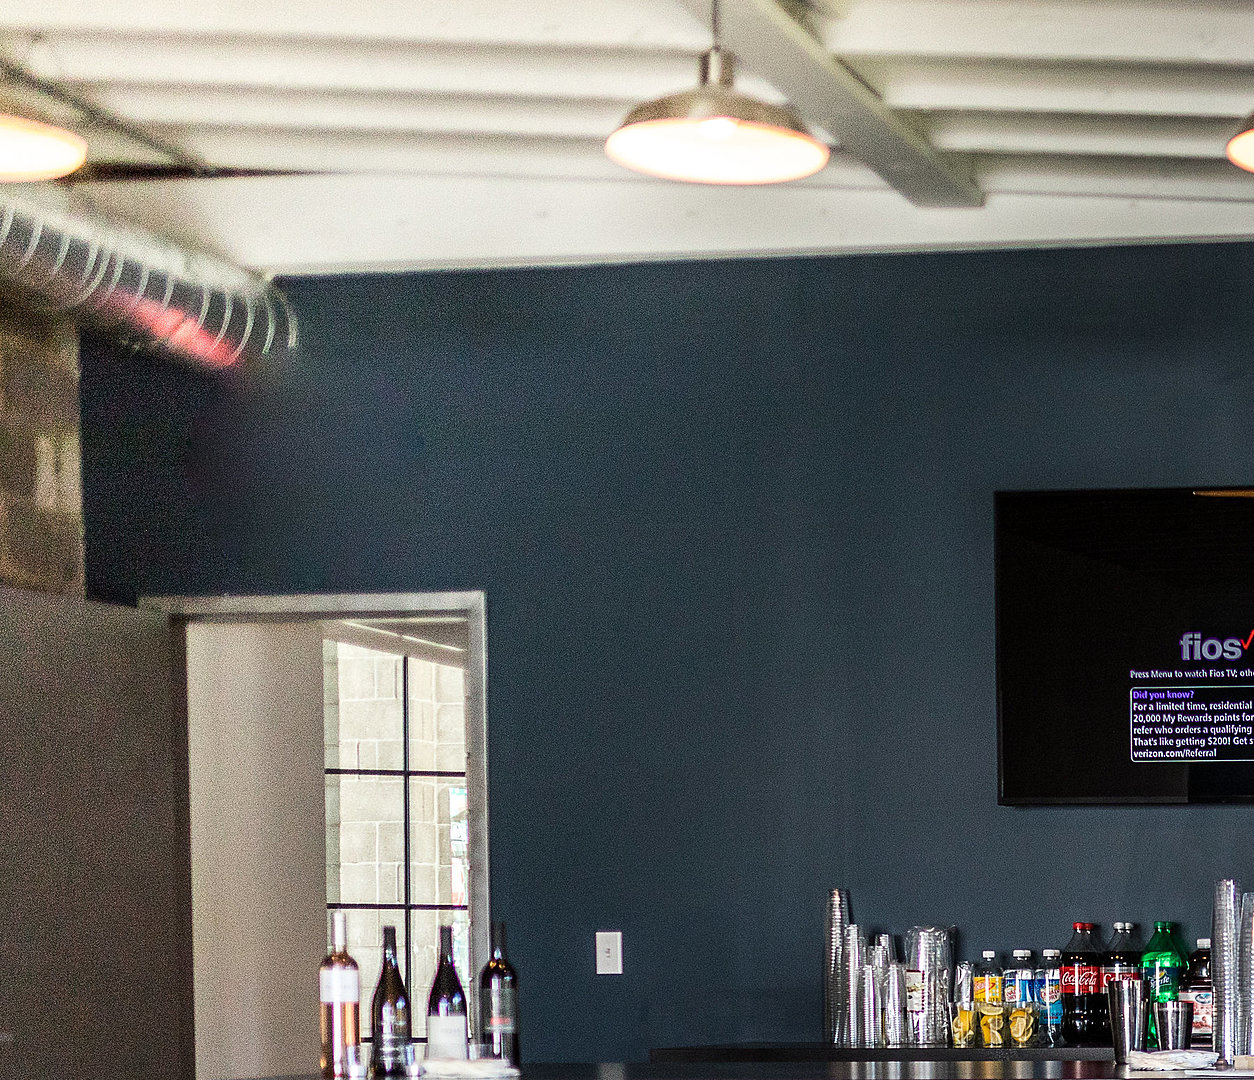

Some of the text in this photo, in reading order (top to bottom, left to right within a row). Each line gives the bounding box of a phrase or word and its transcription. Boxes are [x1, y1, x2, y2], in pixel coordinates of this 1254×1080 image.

[1179, 631, 1242, 661] fios
[1130, 669, 1150, 678] Press
[1151, 669, 1173, 678] Menu
[1175, 670, 1183, 678] to
[1184, 669, 1207, 678] watch
[1209, 669, 1225, 678] Fios
[1133, 690, 1195, 701] Did you know?
[1133, 702, 1147, 711] For
[1156, 701, 1185, 711] limited
[1186, 702, 1208, 711] time,
[1209, 701, 1253, 710] residential
[1133, 714, 1161, 724] 20,000
[1162, 714, 1176, 724] My
[1177, 713, 1212, 723] Rewards
[1213, 713, 1240, 723] points
[1241, 712, 1254, 721] for
[1133, 725, 1153, 735] refer
[1154, 725, 1173, 734] who
[1175, 724, 1201, 734] orders
[1202, 726, 1209, 734] a
[1209, 724, 1253, 736] qualifying
[1133, 737, 1158, 747] That's
[1159, 736, 1175, 746] like
[1175, 737, 1206, 748] getting
[1207, 736, 1231, 746] $200!
[1232, 736, 1248, 745] Get
[1133, 748, 1217, 759] verizon.com/Referral
[1062, 971, 1098, 986] CocaCola
